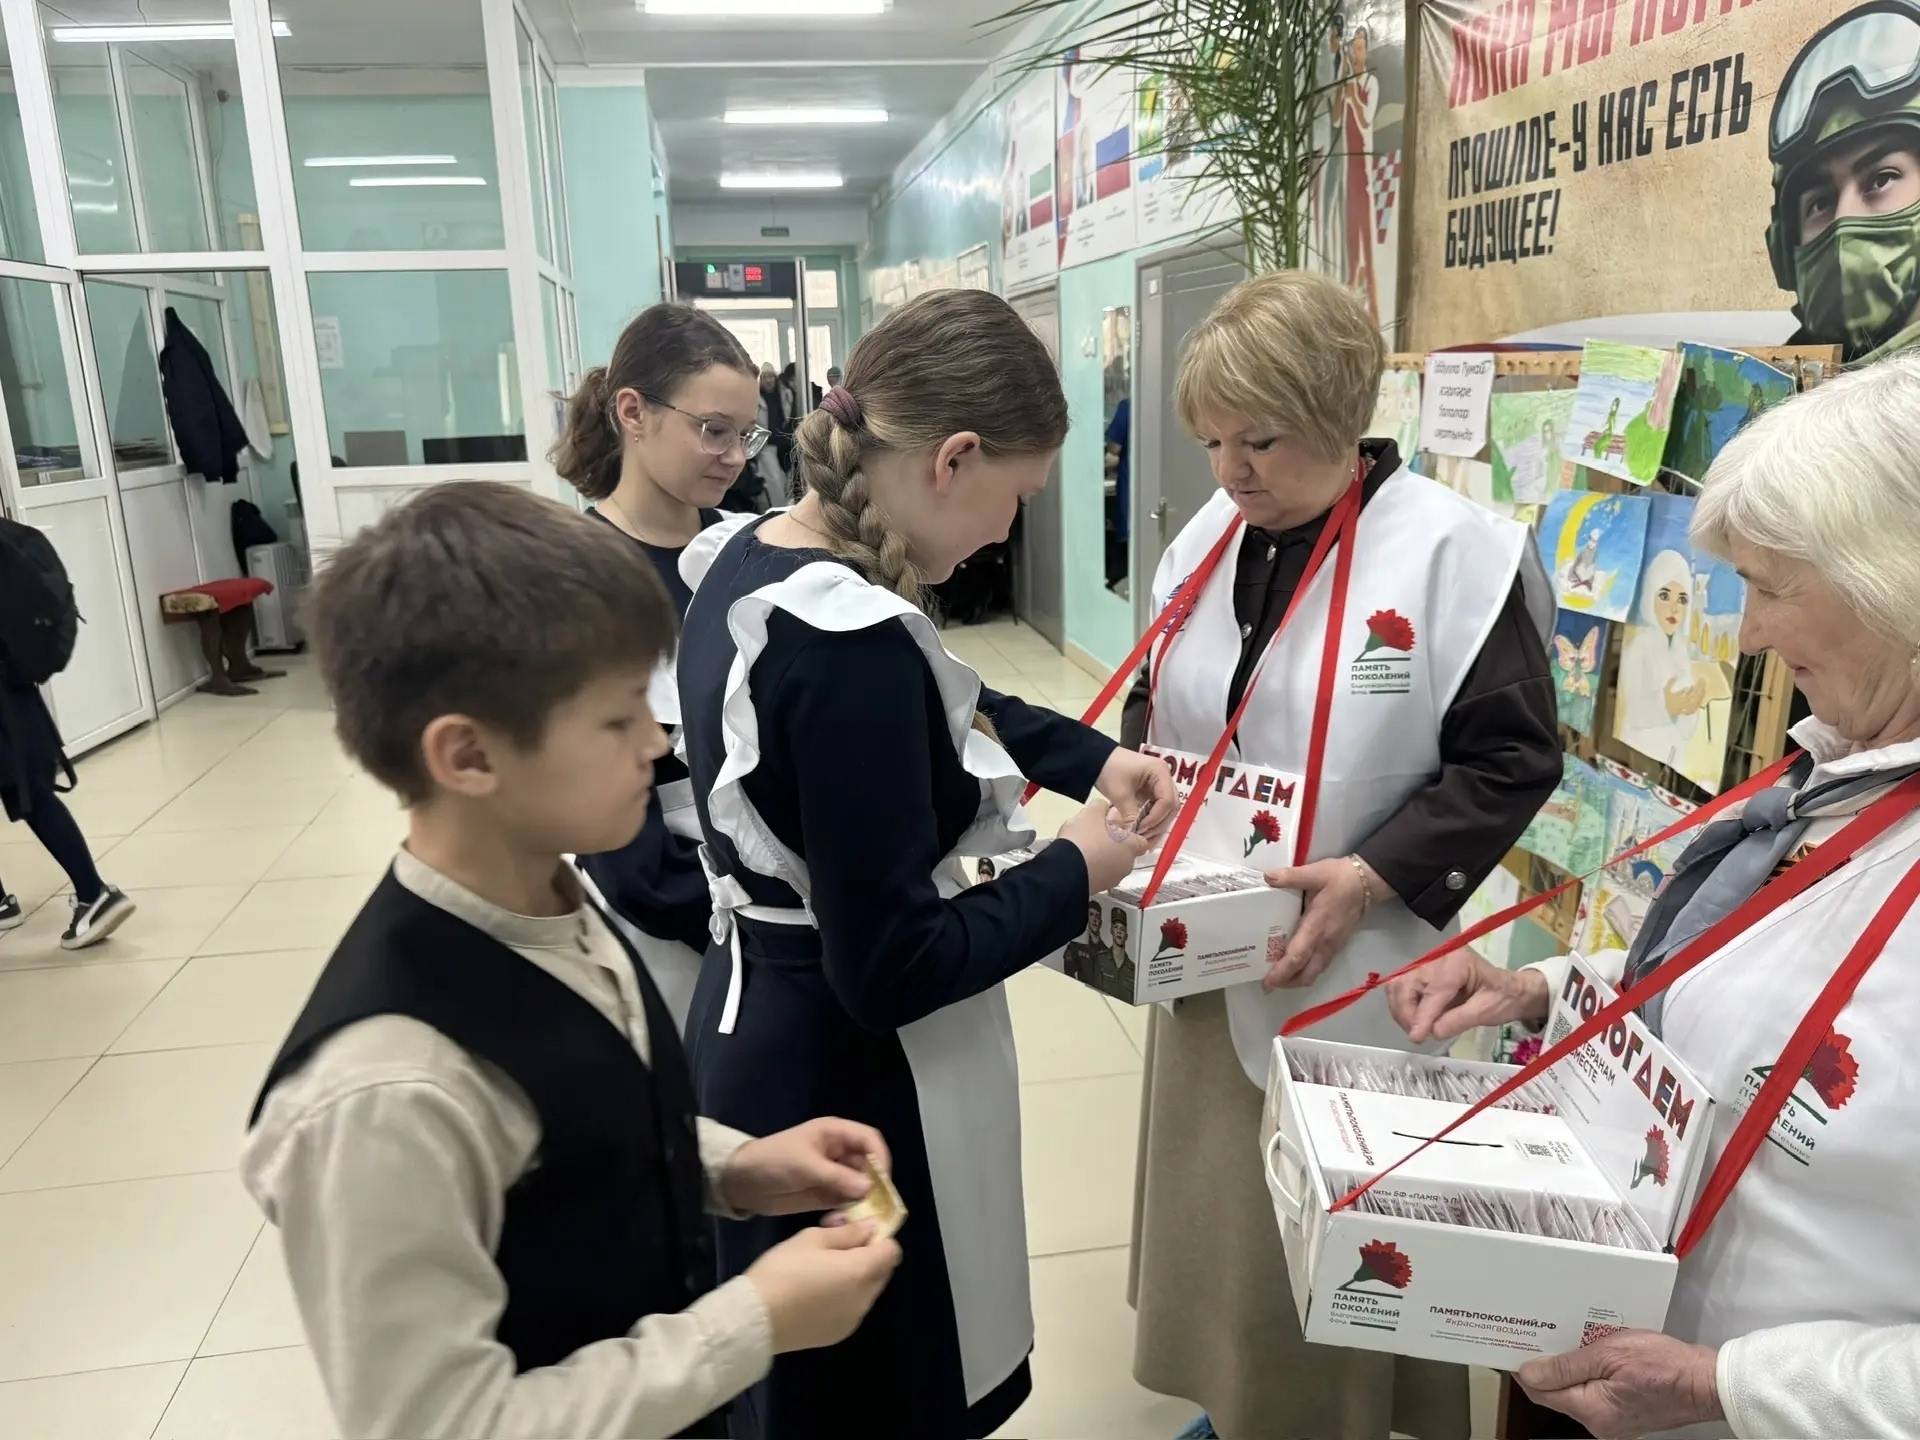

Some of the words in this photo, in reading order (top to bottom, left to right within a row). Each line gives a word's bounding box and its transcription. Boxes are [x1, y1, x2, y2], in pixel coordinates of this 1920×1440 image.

[1598, 80, 1658, 166] НАС
[1665, 52, 1752, 150] ЕСТЬ
[1445, 188, 1561, 270] БУДУЩЕЕ!
[1351, 664, 1391, 672] ПАМЯТЬ
[1351, 671, 1411, 681] ПОКОЛЕНИЙ
[1744, 1074, 1796, 1118] ПАТЬ
[1334, 1293, 1379, 1305] ПАМЯТЬ
[1332, 1302, 1400, 1318] ПОКОЛЕНИЙ
[1429, 1306, 1557, 1330] ПАМЯТЬПОКОЛЕНИЙ.РФ
[1445, 1317, 1537, 1338] #краснаягвоздика
